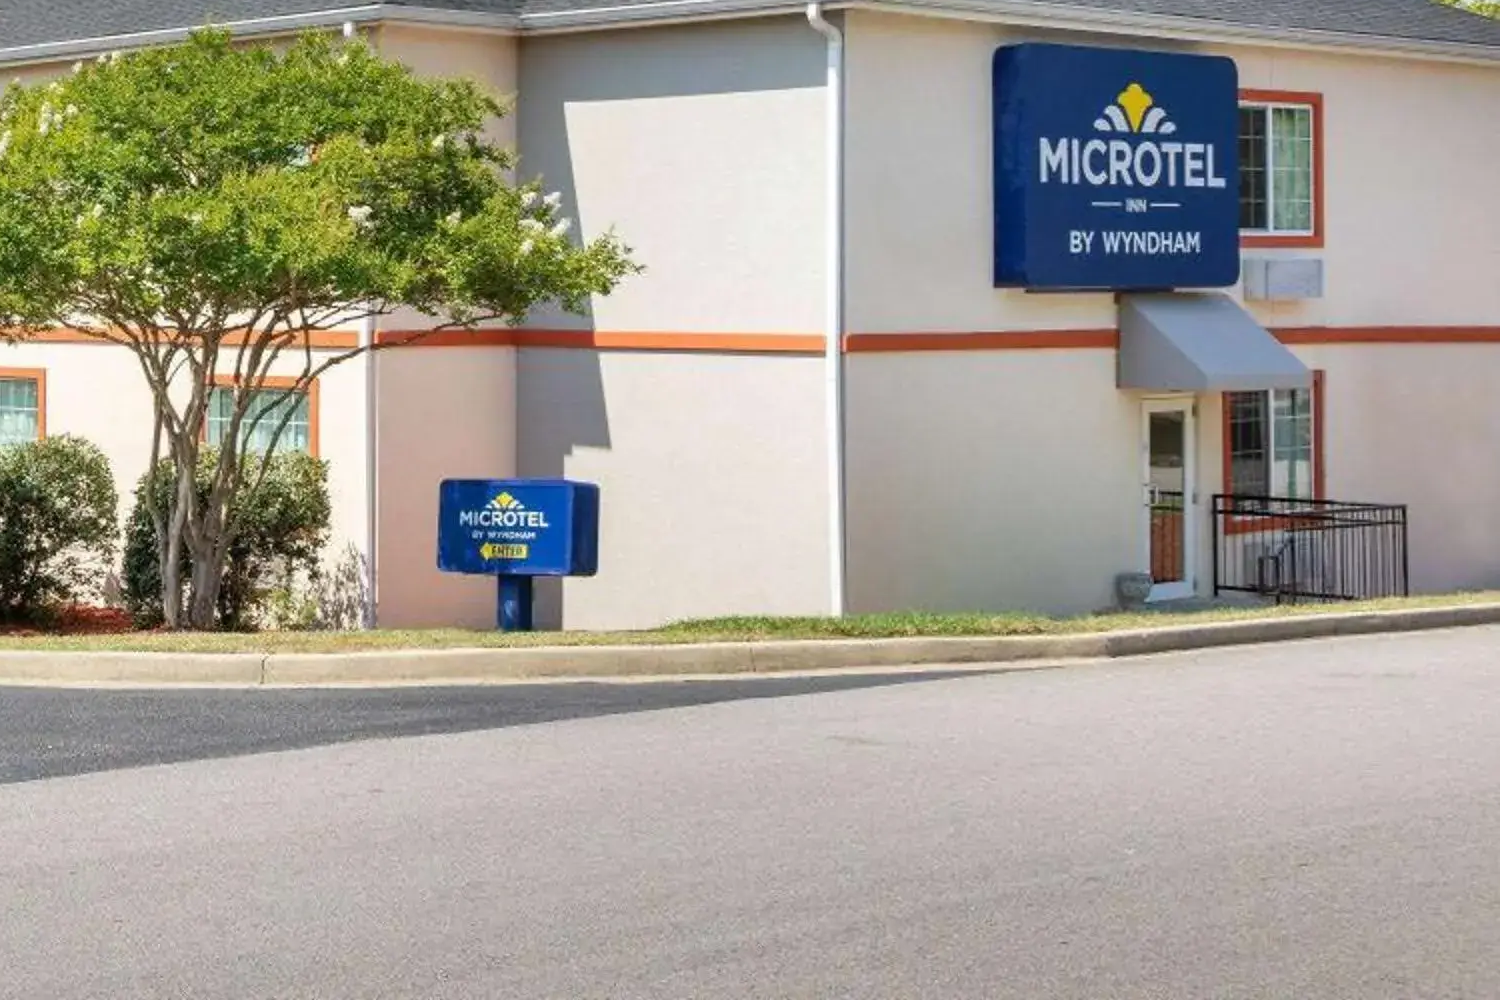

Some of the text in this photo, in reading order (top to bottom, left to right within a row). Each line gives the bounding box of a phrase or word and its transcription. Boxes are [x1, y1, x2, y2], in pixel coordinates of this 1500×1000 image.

[1039, 137, 1226, 188] MICROTEL
[1125, 199, 1147, 212] INN
[1070, 230, 1200, 254] BY WYNDHAM
[459, 511, 548, 527] MICROTEL
